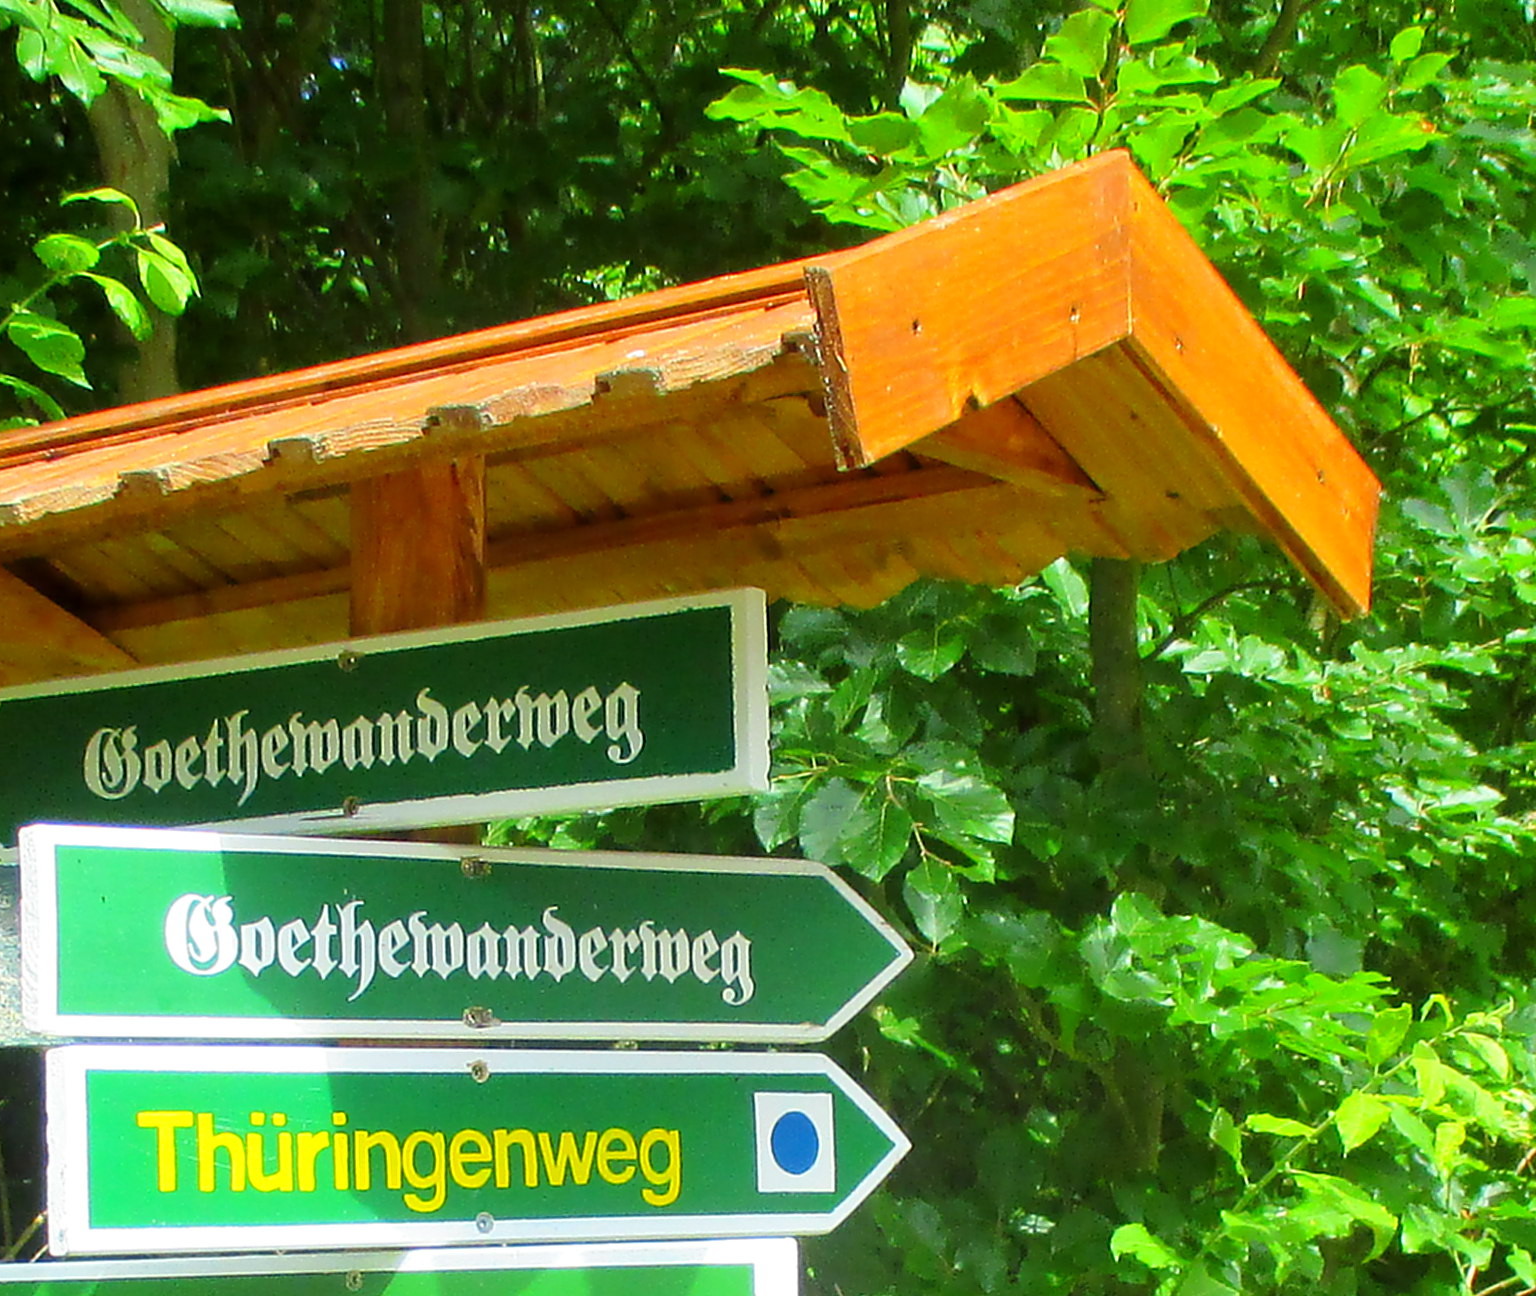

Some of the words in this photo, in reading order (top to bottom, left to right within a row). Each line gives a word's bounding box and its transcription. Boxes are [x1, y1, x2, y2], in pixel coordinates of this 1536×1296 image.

[83, 681, 644, 806] Goethewanderweg
[165, 892, 753, 1004] Goethewanderweg
[137, 1110, 680, 1212] Thüringenweg
